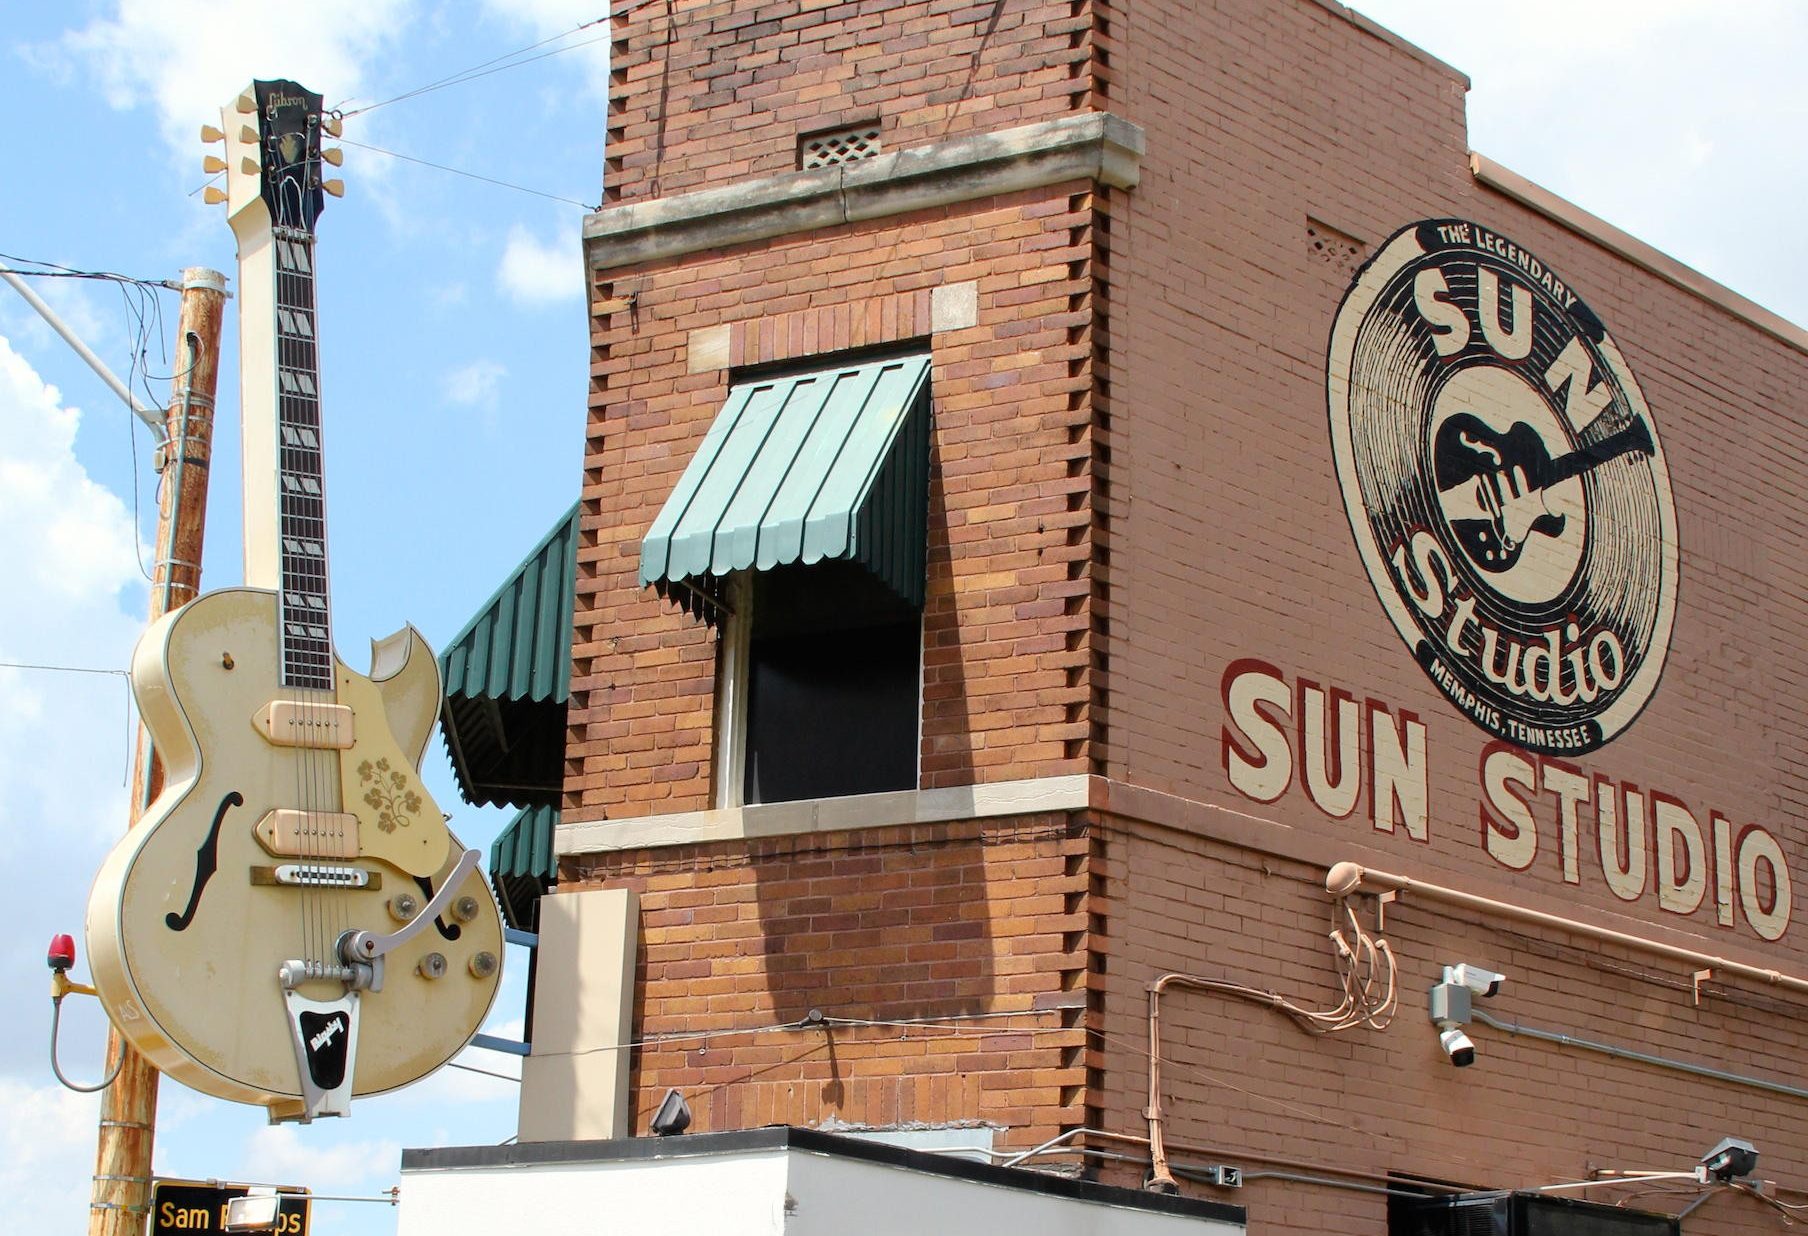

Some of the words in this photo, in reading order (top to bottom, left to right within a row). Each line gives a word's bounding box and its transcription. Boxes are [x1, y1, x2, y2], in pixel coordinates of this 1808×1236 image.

[269, 91, 308, 111] Gibson
[1437, 224, 1471, 245] THE
[1475, 226, 1578, 310] LEGENDARY
[1414, 266, 1613, 434] SUN
[1391, 530, 1624, 706] Studio
[1508, 720, 1592, 750] TENNESSEE
[1223, 662, 1429, 844] SUN
[1481, 744, 1793, 942] STUDIO
[160, 1201, 210, 1230] Sam
